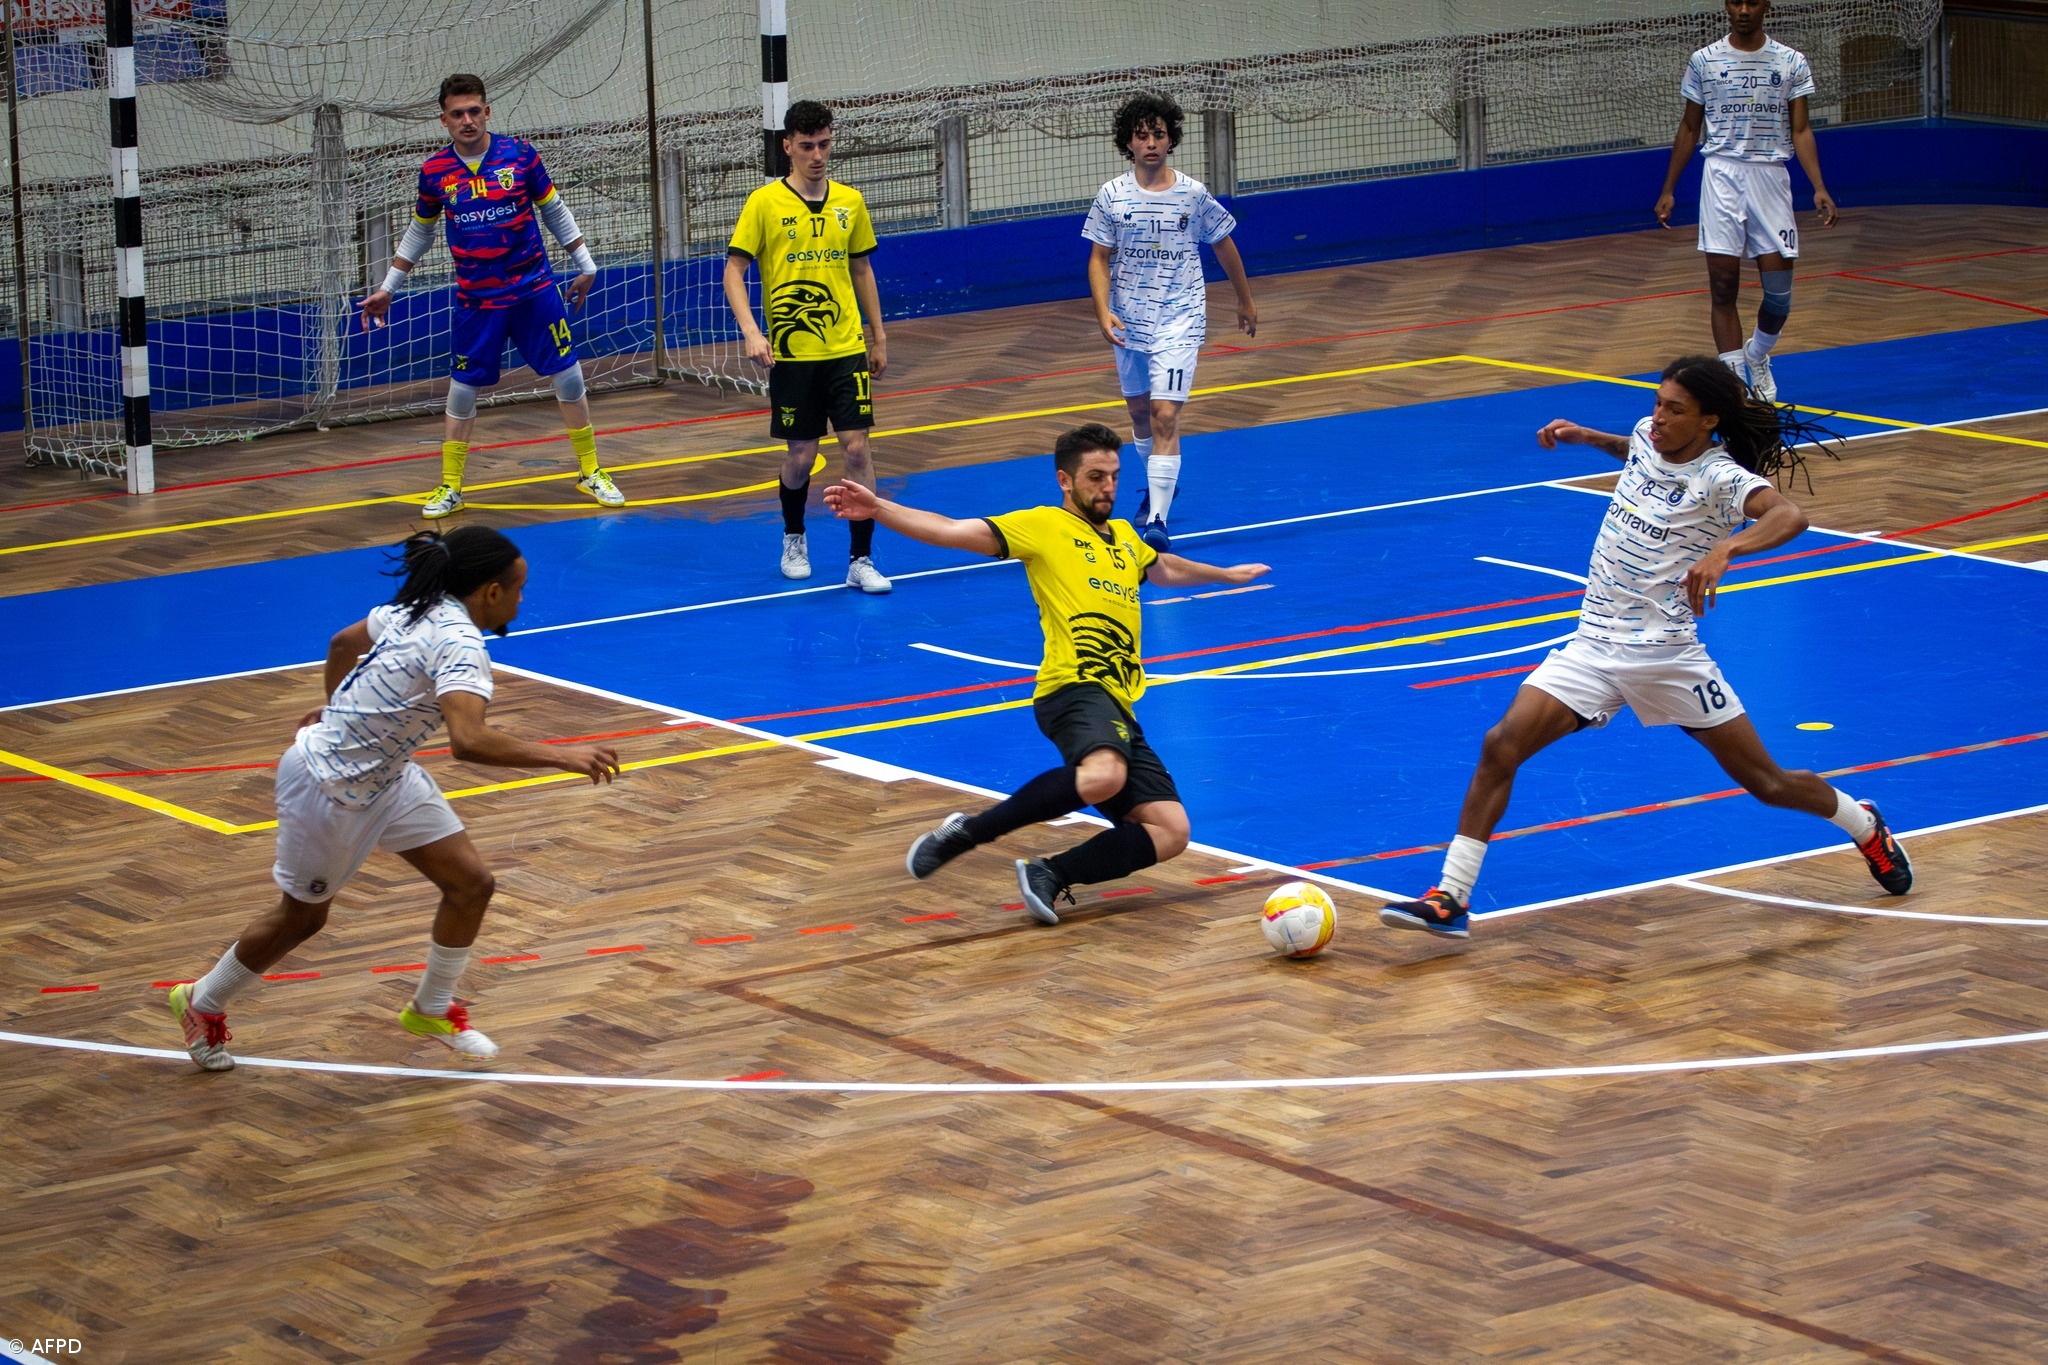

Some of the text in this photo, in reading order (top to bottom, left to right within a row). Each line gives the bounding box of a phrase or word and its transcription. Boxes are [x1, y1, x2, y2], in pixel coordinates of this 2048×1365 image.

[1742, 76, 1758, 89] 20
[1720, 102, 1781, 114] azortravel
[468, 177, 488, 200] 14
[453, 202, 518, 224] easygest
[782, 216, 797, 226] DK
[809, 217, 826, 238] 17
[1150, 219, 1161, 234] 11
[1778, 228, 1796, 250] 20
[548, 317, 572, 347] 14
[852, 371, 870, 401] 17
[1167, 367, 1184, 392] 11
[1105, 547, 1126, 571] 15
[1692, 678, 1727, 715] 18
